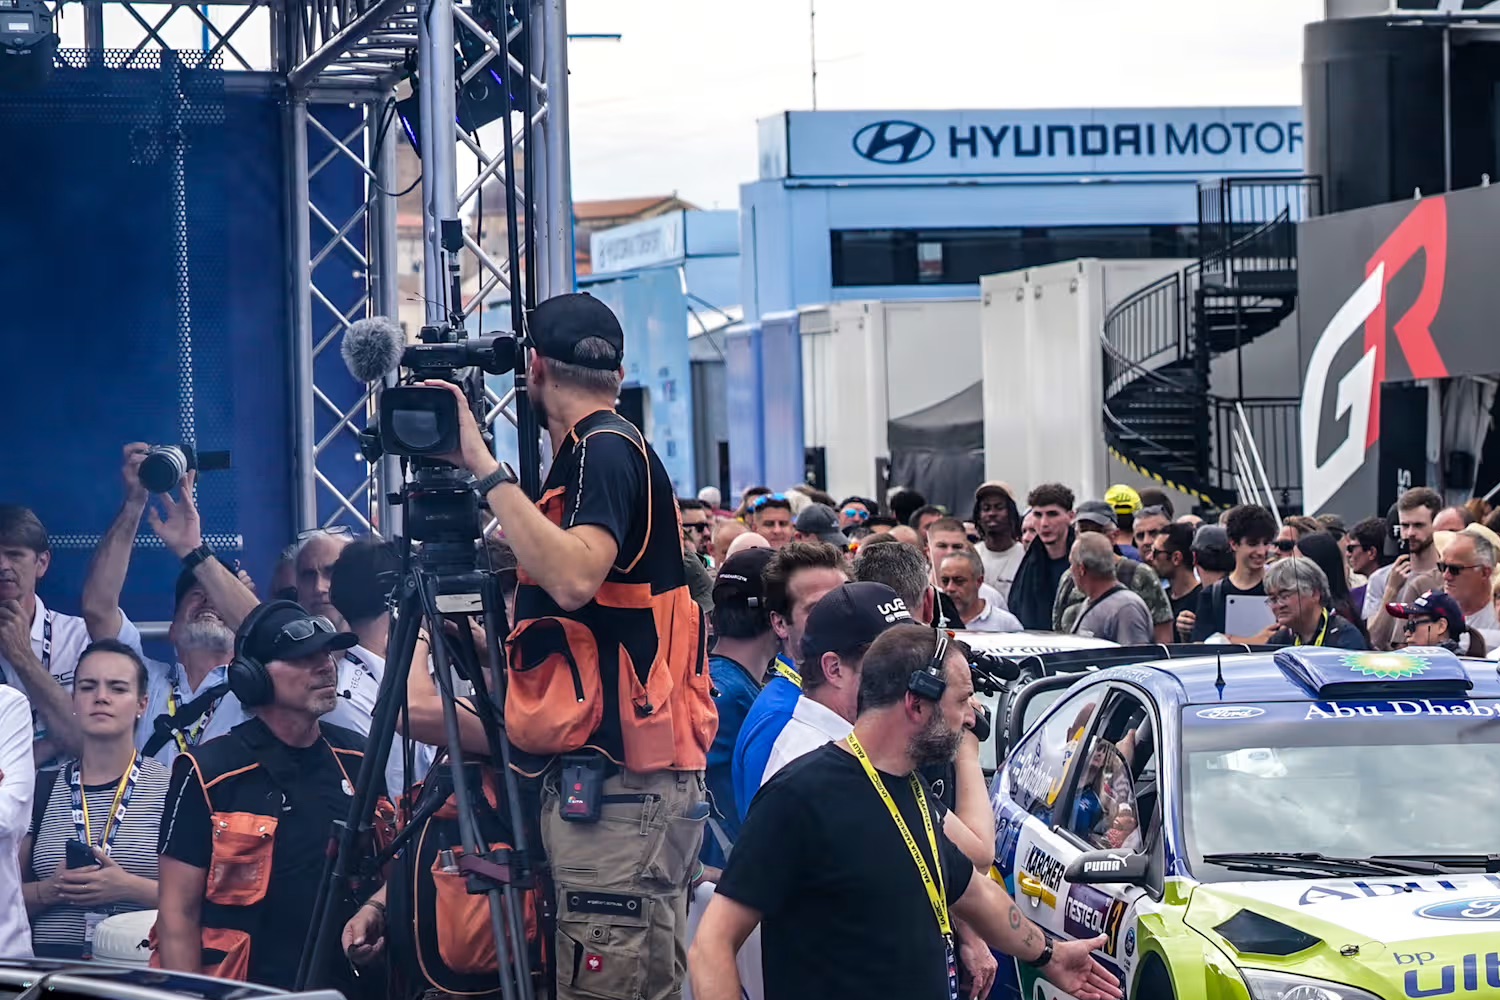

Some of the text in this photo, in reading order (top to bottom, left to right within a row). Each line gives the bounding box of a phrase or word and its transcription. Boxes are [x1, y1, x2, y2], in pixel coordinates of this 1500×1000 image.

[948, 123, 1156, 158] HYUNDAI
[1303, 701, 1382, 721] Abu
[894, 814, 930, 884] RALLY ITALIA SARDEGNA
[1084, 860, 1121, 873] PUMA
[1298, 877, 1457, 906] Abu
[1393, 951, 1436, 967] bp
